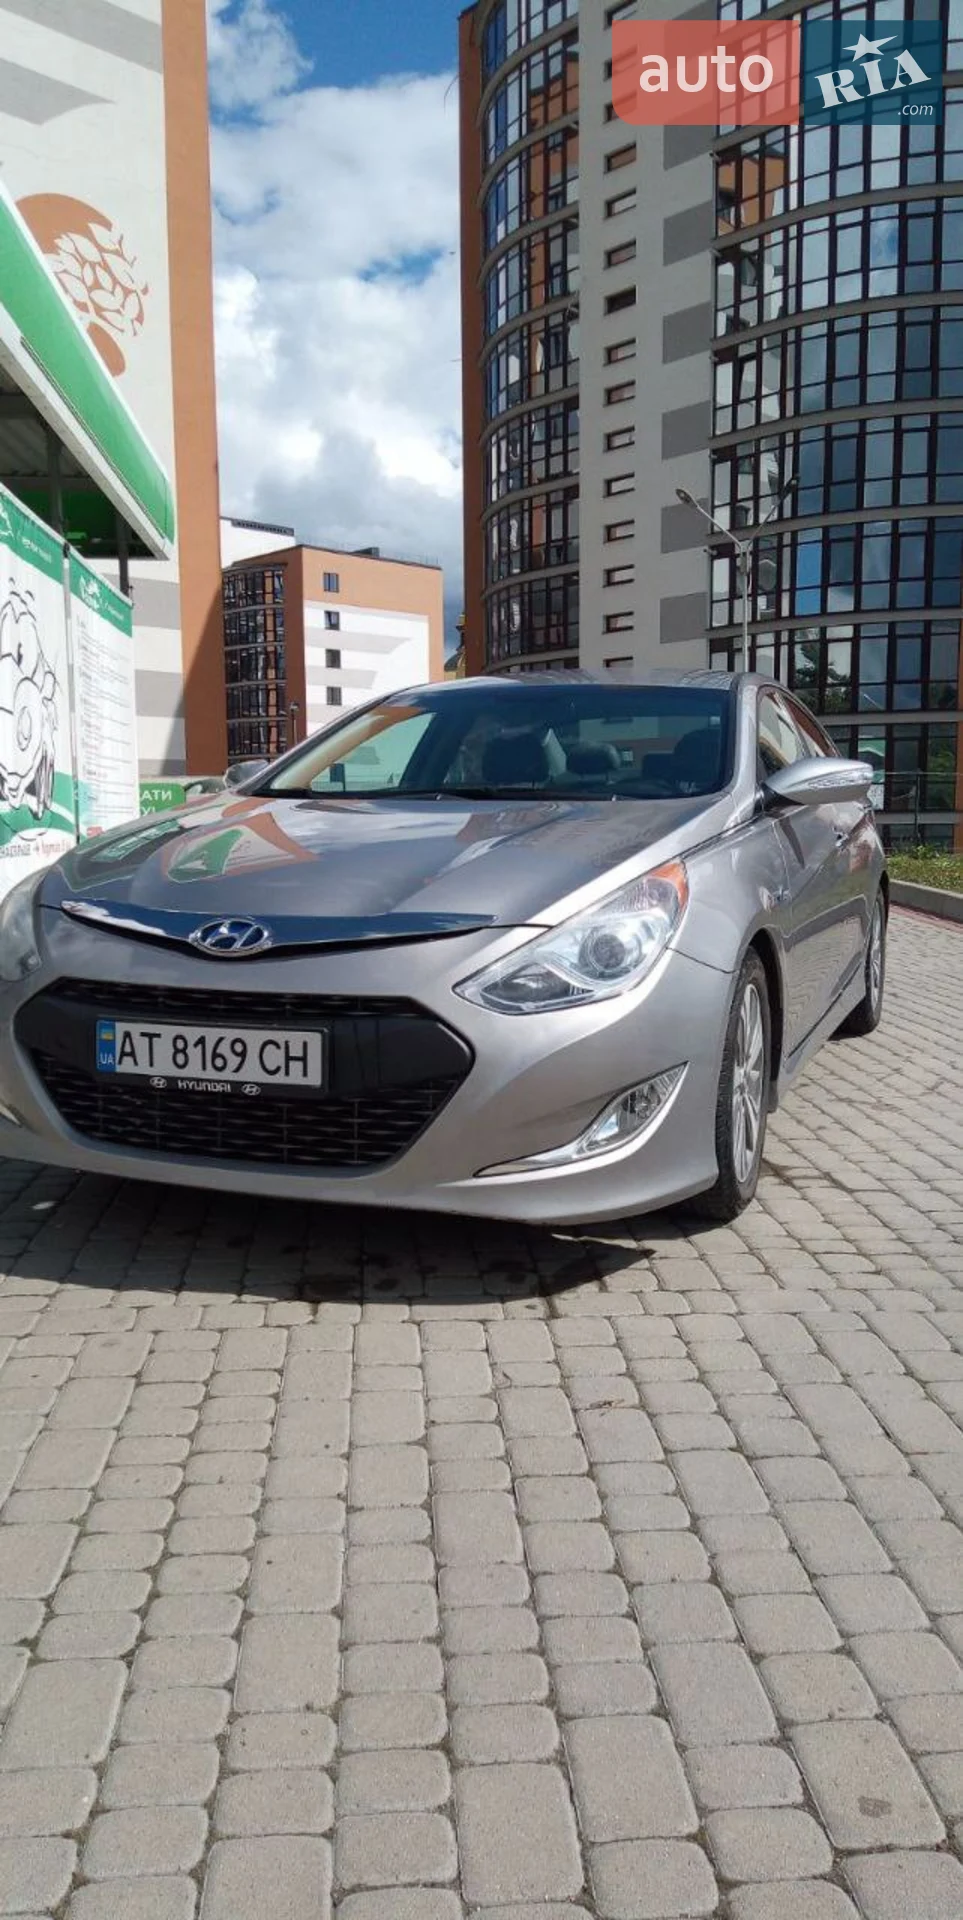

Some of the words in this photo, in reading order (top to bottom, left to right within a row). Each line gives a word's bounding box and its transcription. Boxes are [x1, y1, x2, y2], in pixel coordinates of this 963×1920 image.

[100, 1053, 115, 1066] UA
[117, 1030, 162, 1068] AT
[172, 1034, 248, 1074] 8169
[258, 1039, 308, 1078] CH
[177, 1079, 231, 1093] HYUNDAI
